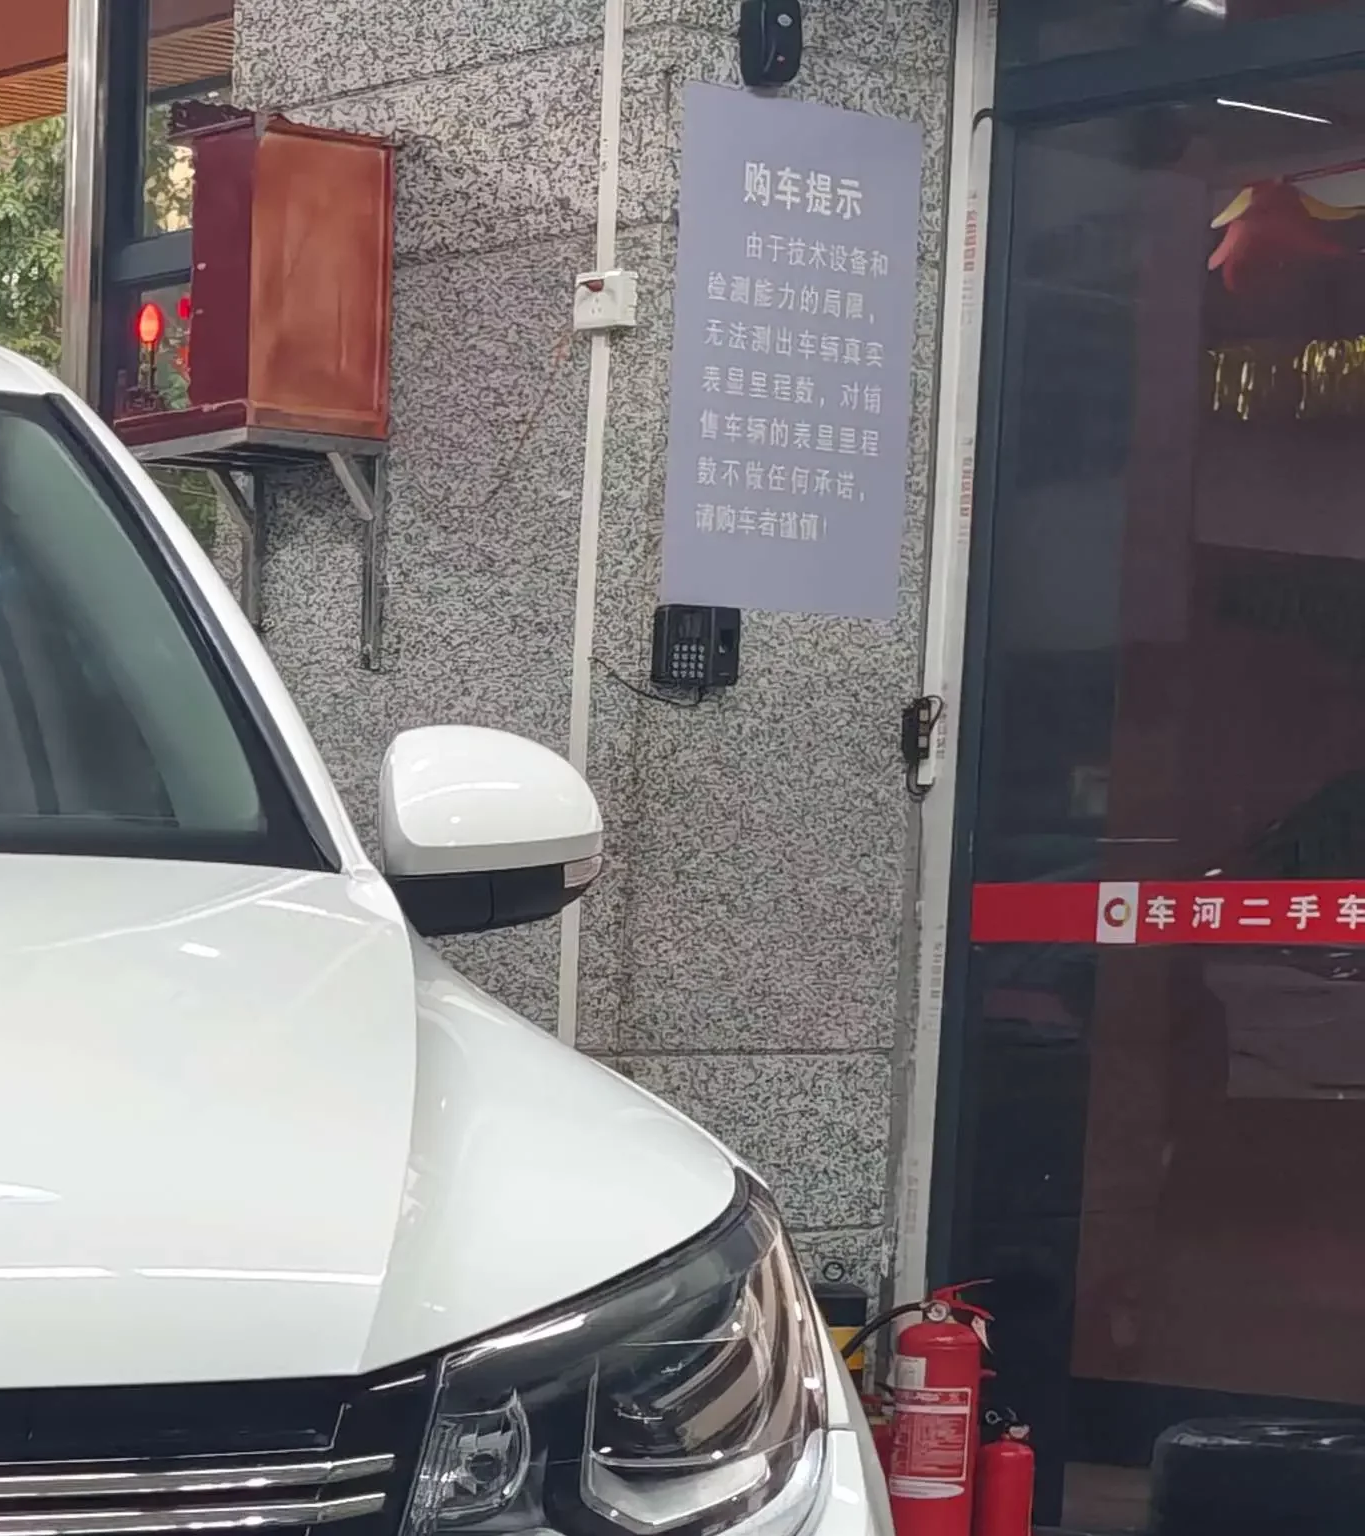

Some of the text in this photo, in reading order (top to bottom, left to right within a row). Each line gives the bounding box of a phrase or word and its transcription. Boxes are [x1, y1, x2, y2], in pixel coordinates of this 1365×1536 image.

[743, 160, 863, 221] 购车提示
[745, 231, 889, 279] 由于技术设备和
[703, 318, 884, 368] 无法测出车辆真实
[699, 407, 879, 457] 售车辆的表显里程
[1145, 895, 1365, 930] 车河二手车
